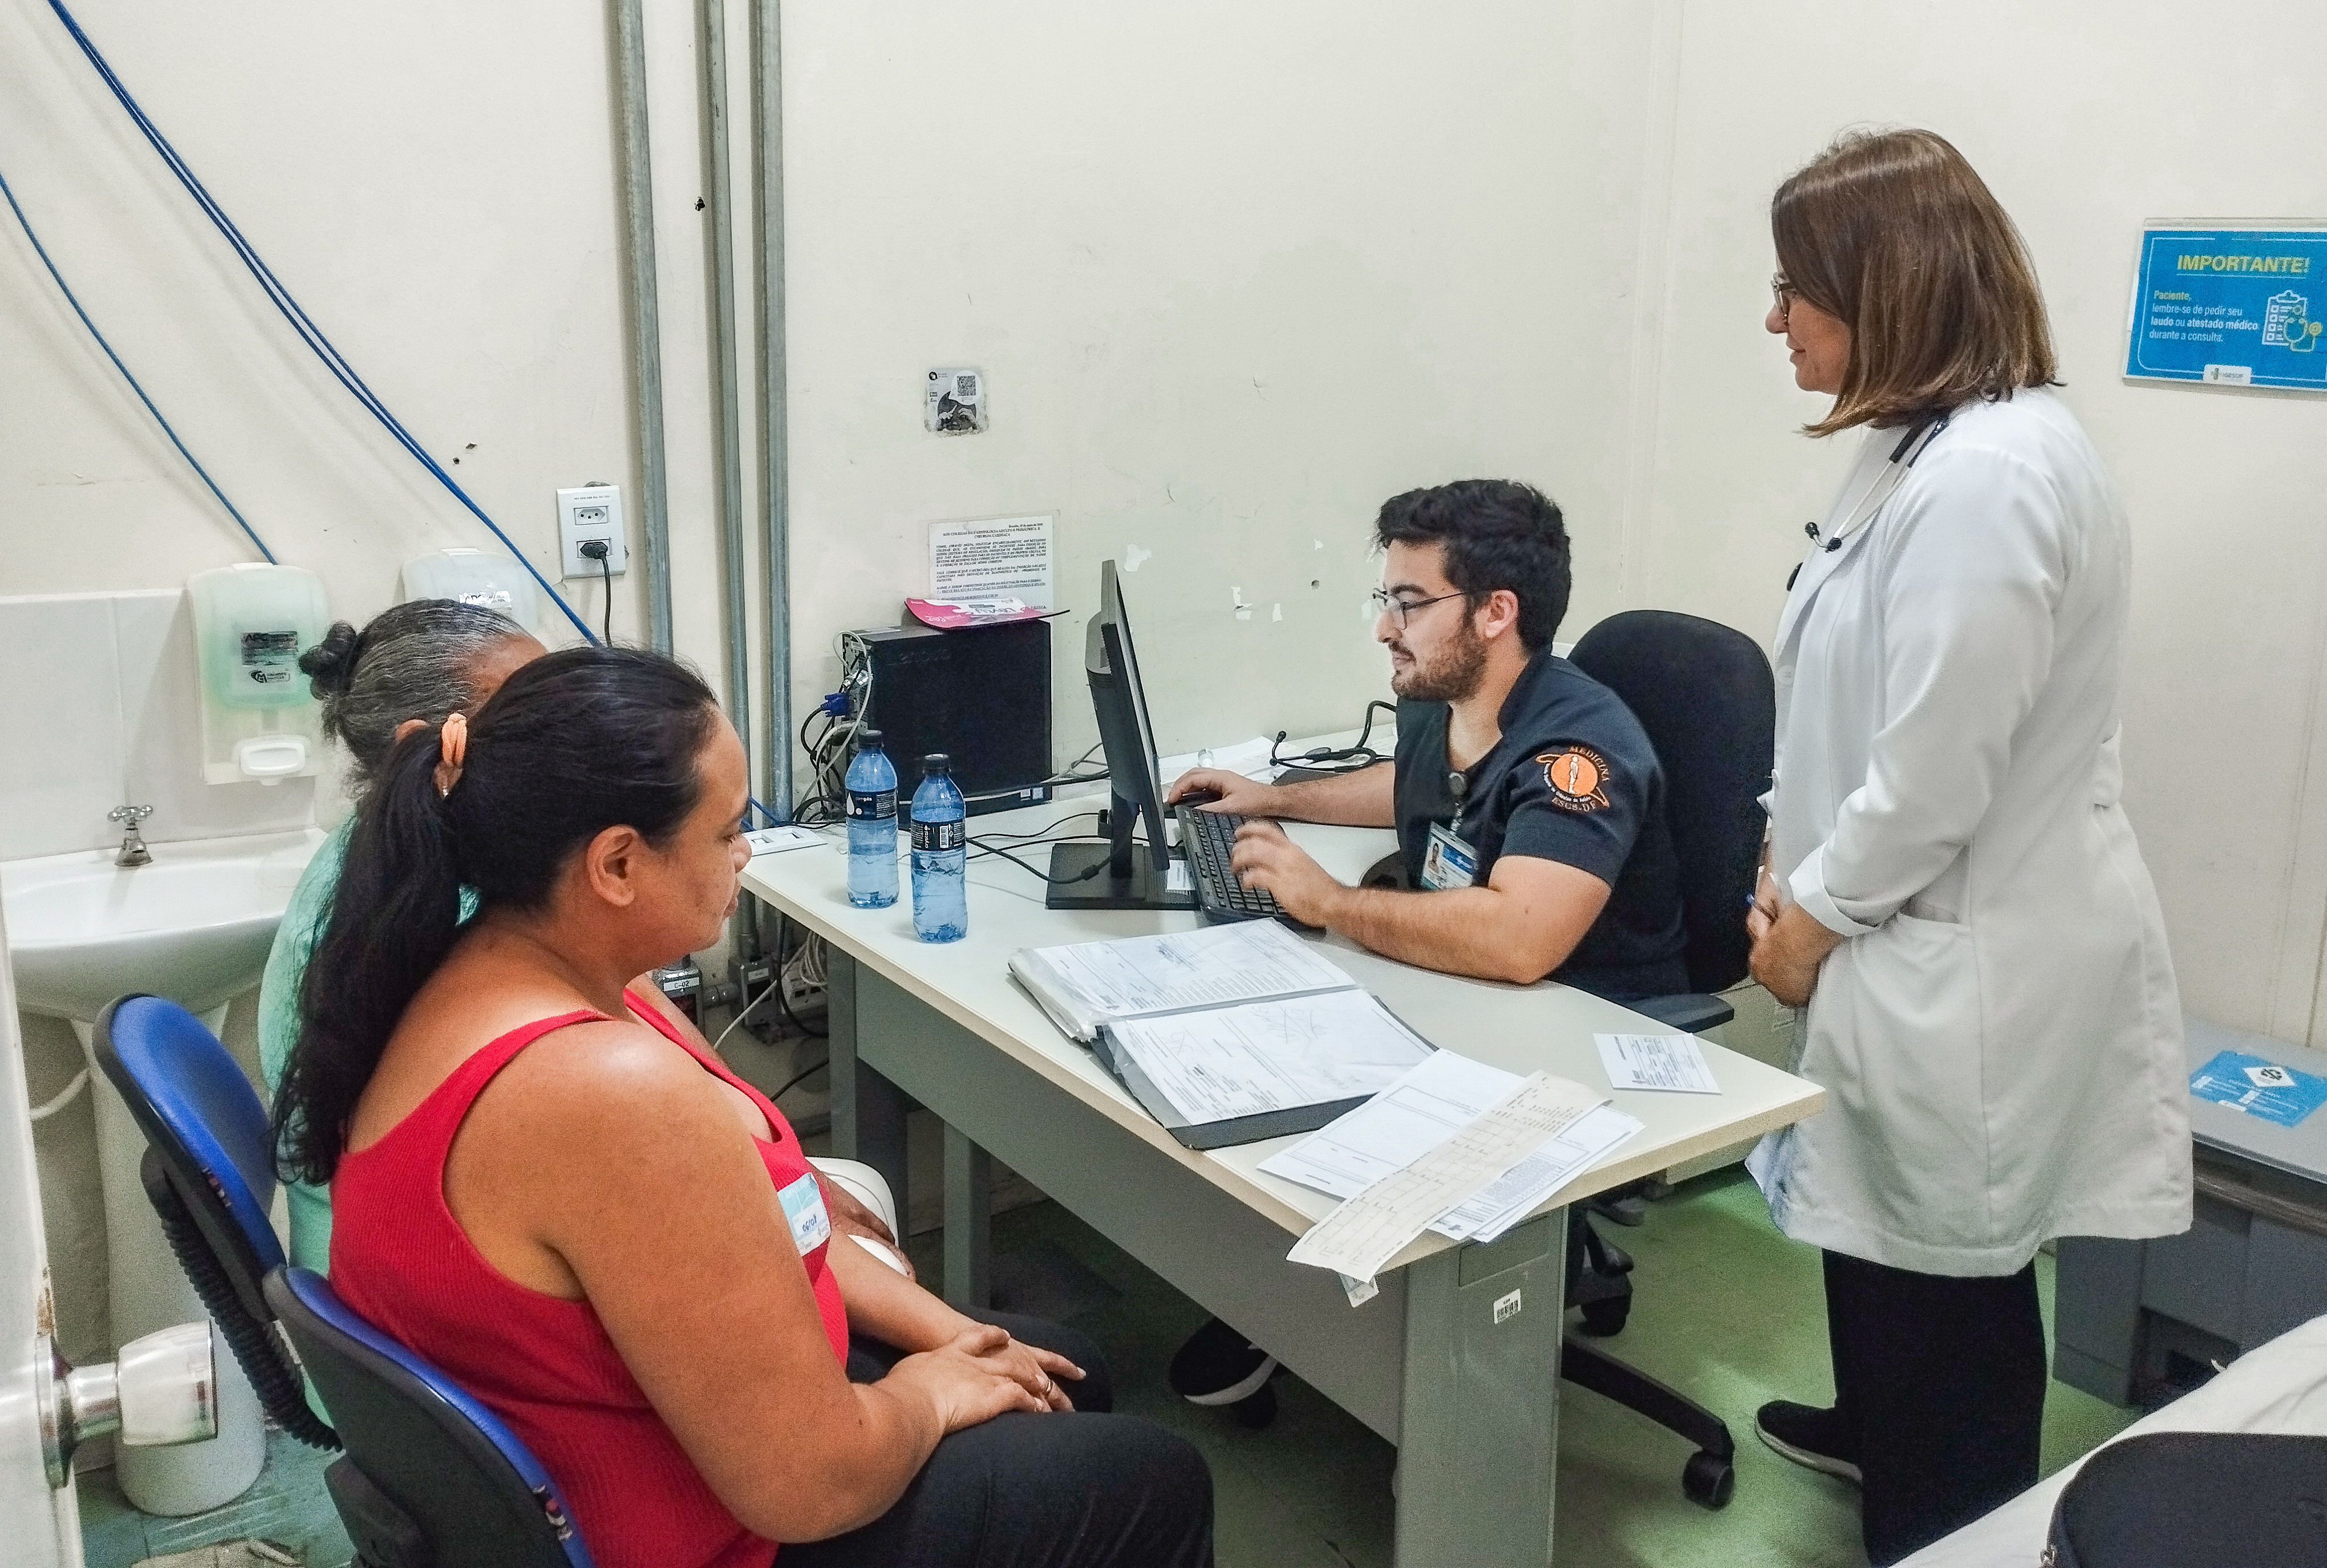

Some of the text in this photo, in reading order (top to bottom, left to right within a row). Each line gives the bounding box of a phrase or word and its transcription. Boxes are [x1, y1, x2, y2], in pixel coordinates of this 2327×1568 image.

[2177, 255, 2310, 273] IMPORTANTE!
[2154, 290, 2192, 302] Paciente,
[2152, 303, 2243, 317] lembre-se de pedir seu
[2151, 316, 2174, 326] laudo
[2187, 318, 2224, 329] atestado
[2225, 319, 2258, 330] médico
[2149, 329, 2179, 339] durante
[1568, 745, 1610, 781] MEDICINA
